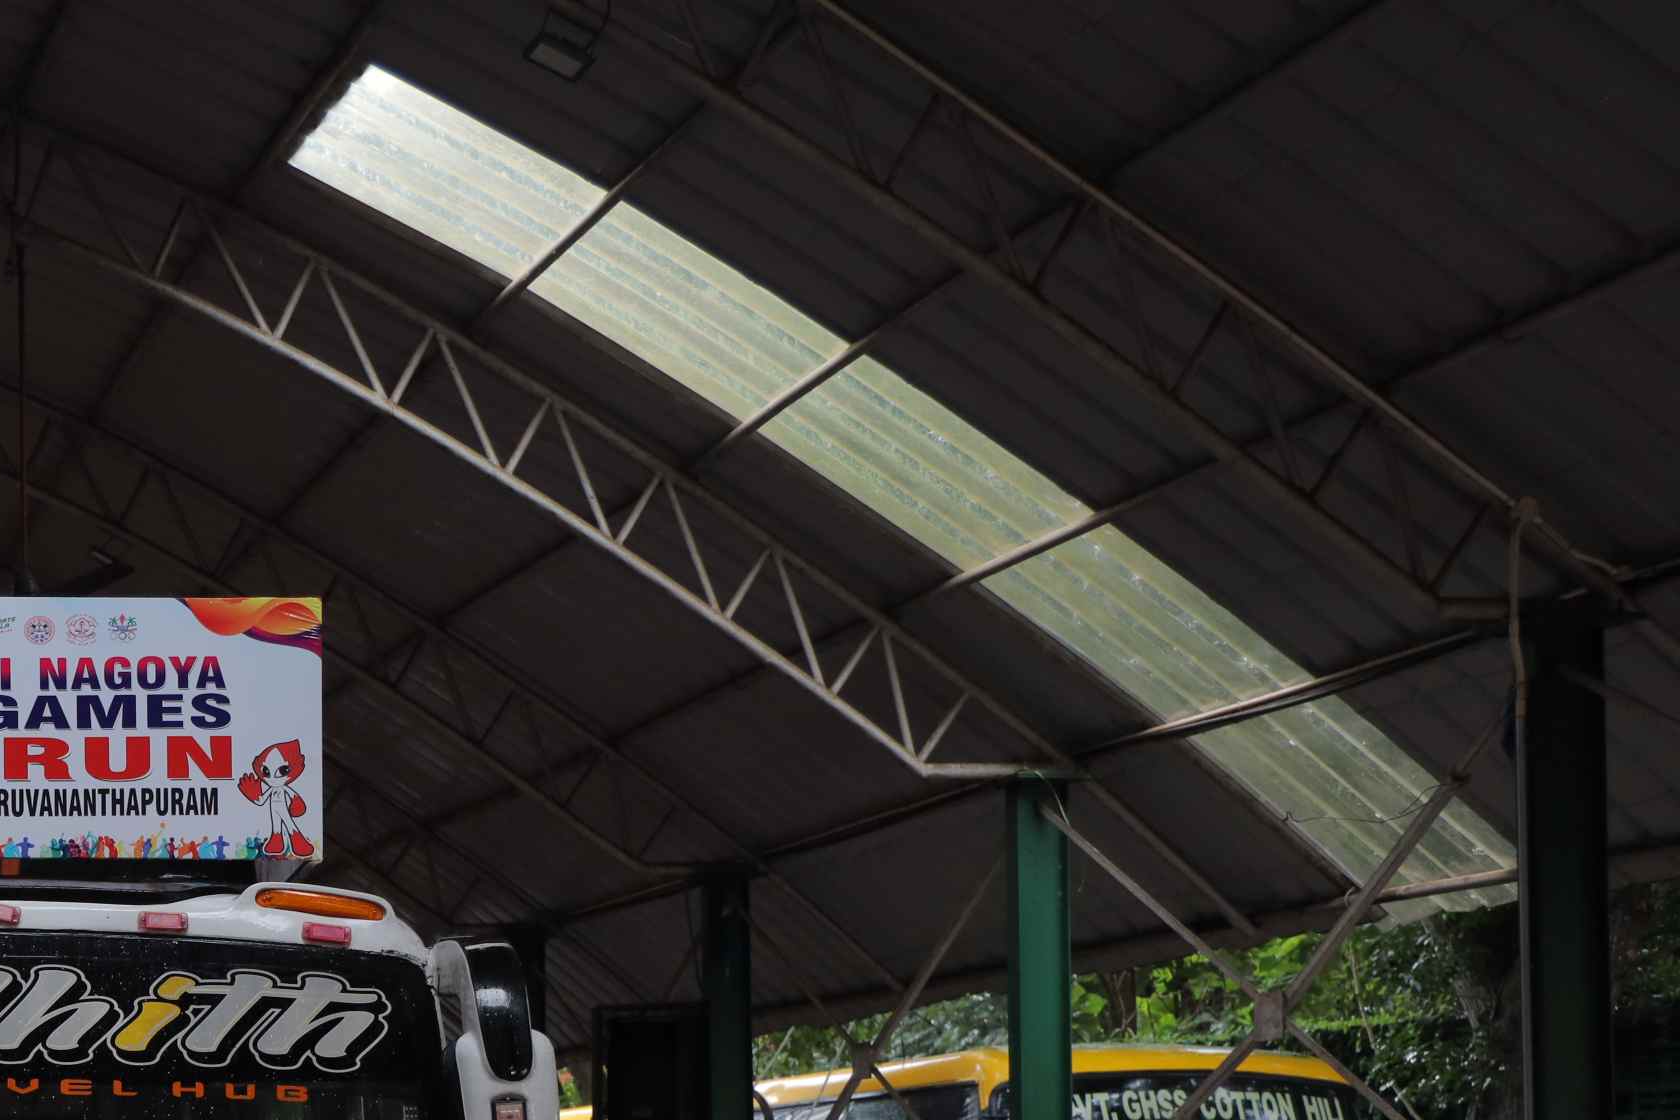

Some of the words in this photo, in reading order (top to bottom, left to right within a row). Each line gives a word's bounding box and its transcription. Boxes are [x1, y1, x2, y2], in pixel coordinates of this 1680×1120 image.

[39, 655, 226, 691] NAGOYA
[4, 736, 234, 782] RUN
[172, 1081, 309, 1102] HUB
[1122, 1088, 1188, 1120] GHSS
